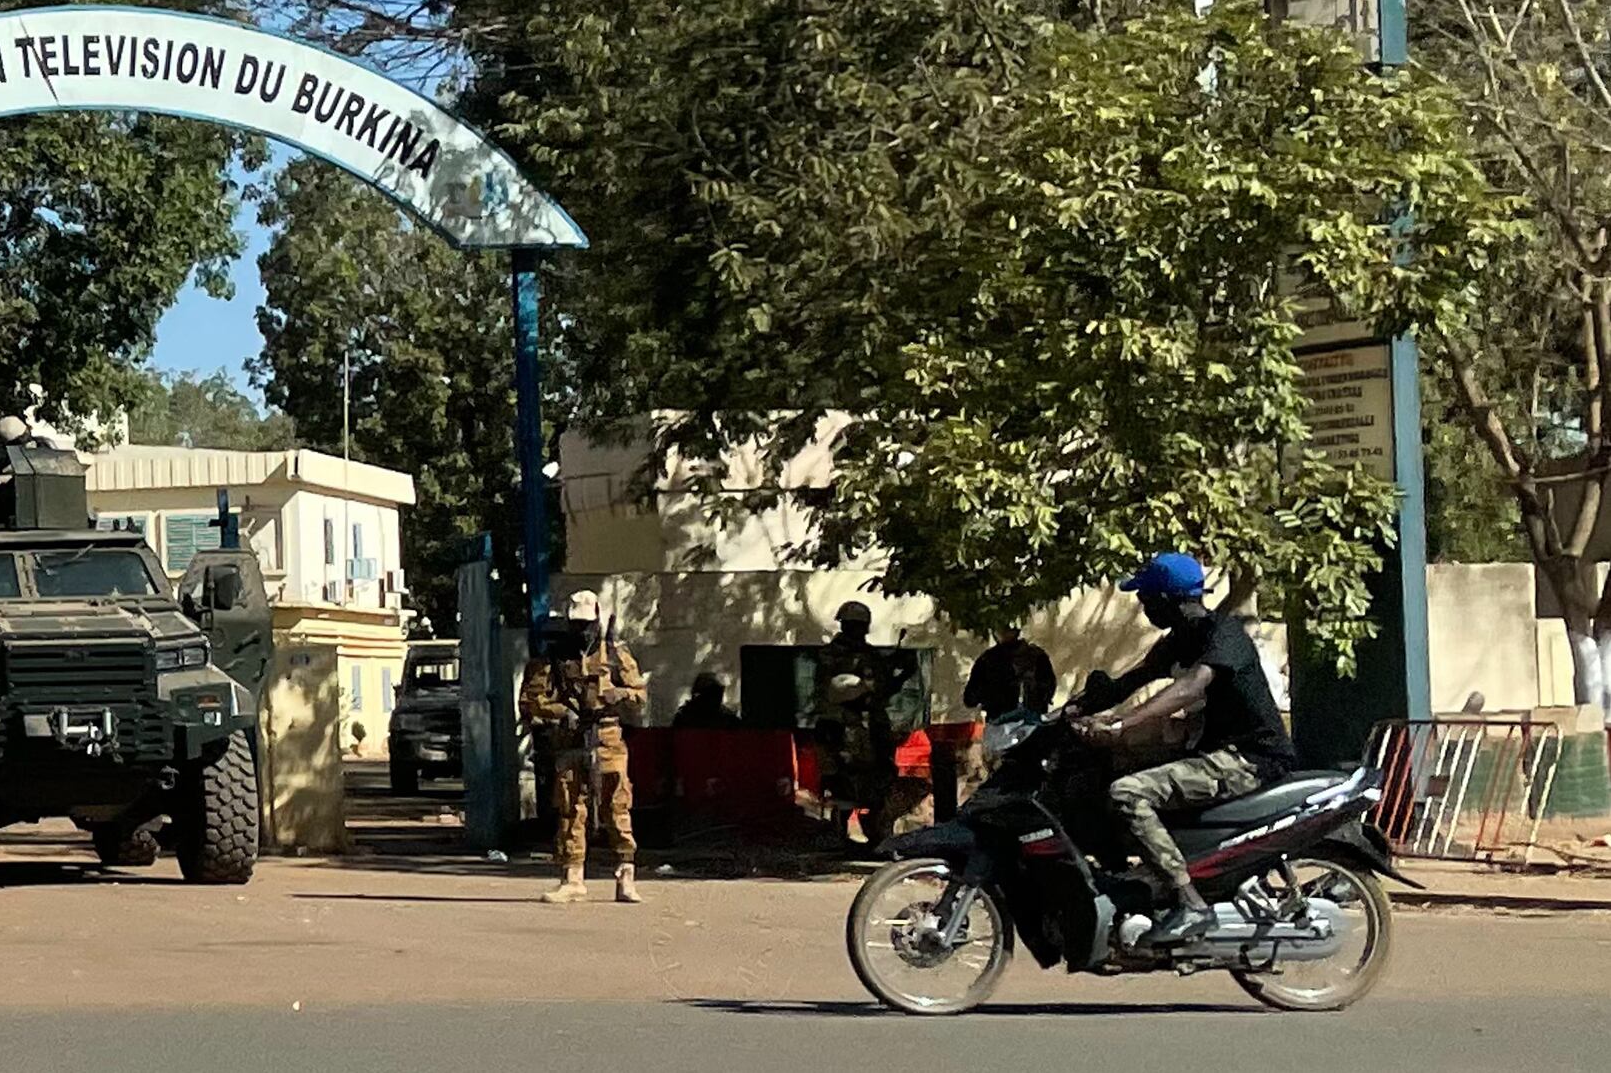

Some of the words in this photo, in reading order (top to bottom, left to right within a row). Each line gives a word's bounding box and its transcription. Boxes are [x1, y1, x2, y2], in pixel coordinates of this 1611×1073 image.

[15, 34, 226, 89] TELEVISION
[234, 53, 286, 103] DU
[291, 72, 440, 180] BURKINA
